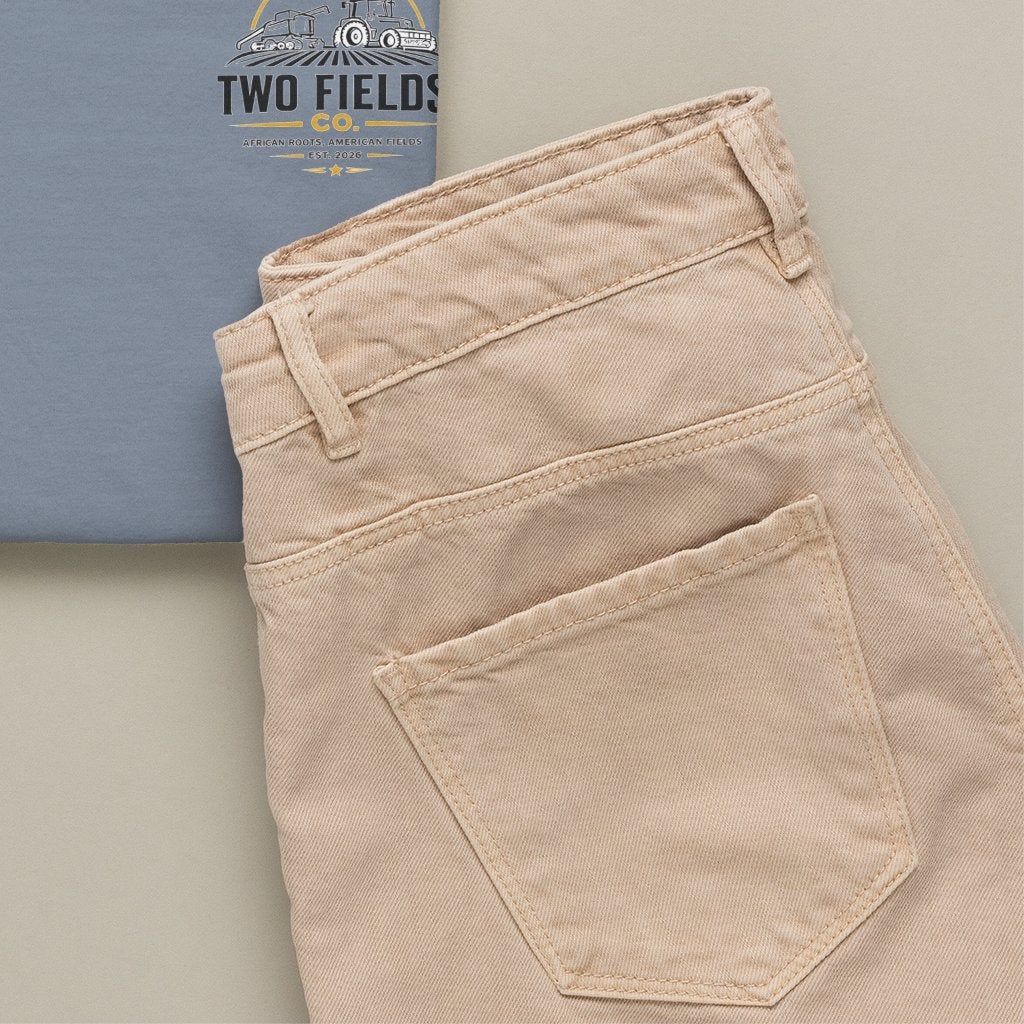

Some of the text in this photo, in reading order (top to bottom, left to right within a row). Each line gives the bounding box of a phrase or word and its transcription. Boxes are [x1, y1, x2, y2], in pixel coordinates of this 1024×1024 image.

[217, 74, 298, 115] TWO
[311, 113, 360, 132] CO.
[243, 139, 285, 147] AFRICAN
[328, 138, 383, 146] AMERICAN
[386, 137, 422, 146] FIELDS
[308, 150, 362, 160] EST. 2026
